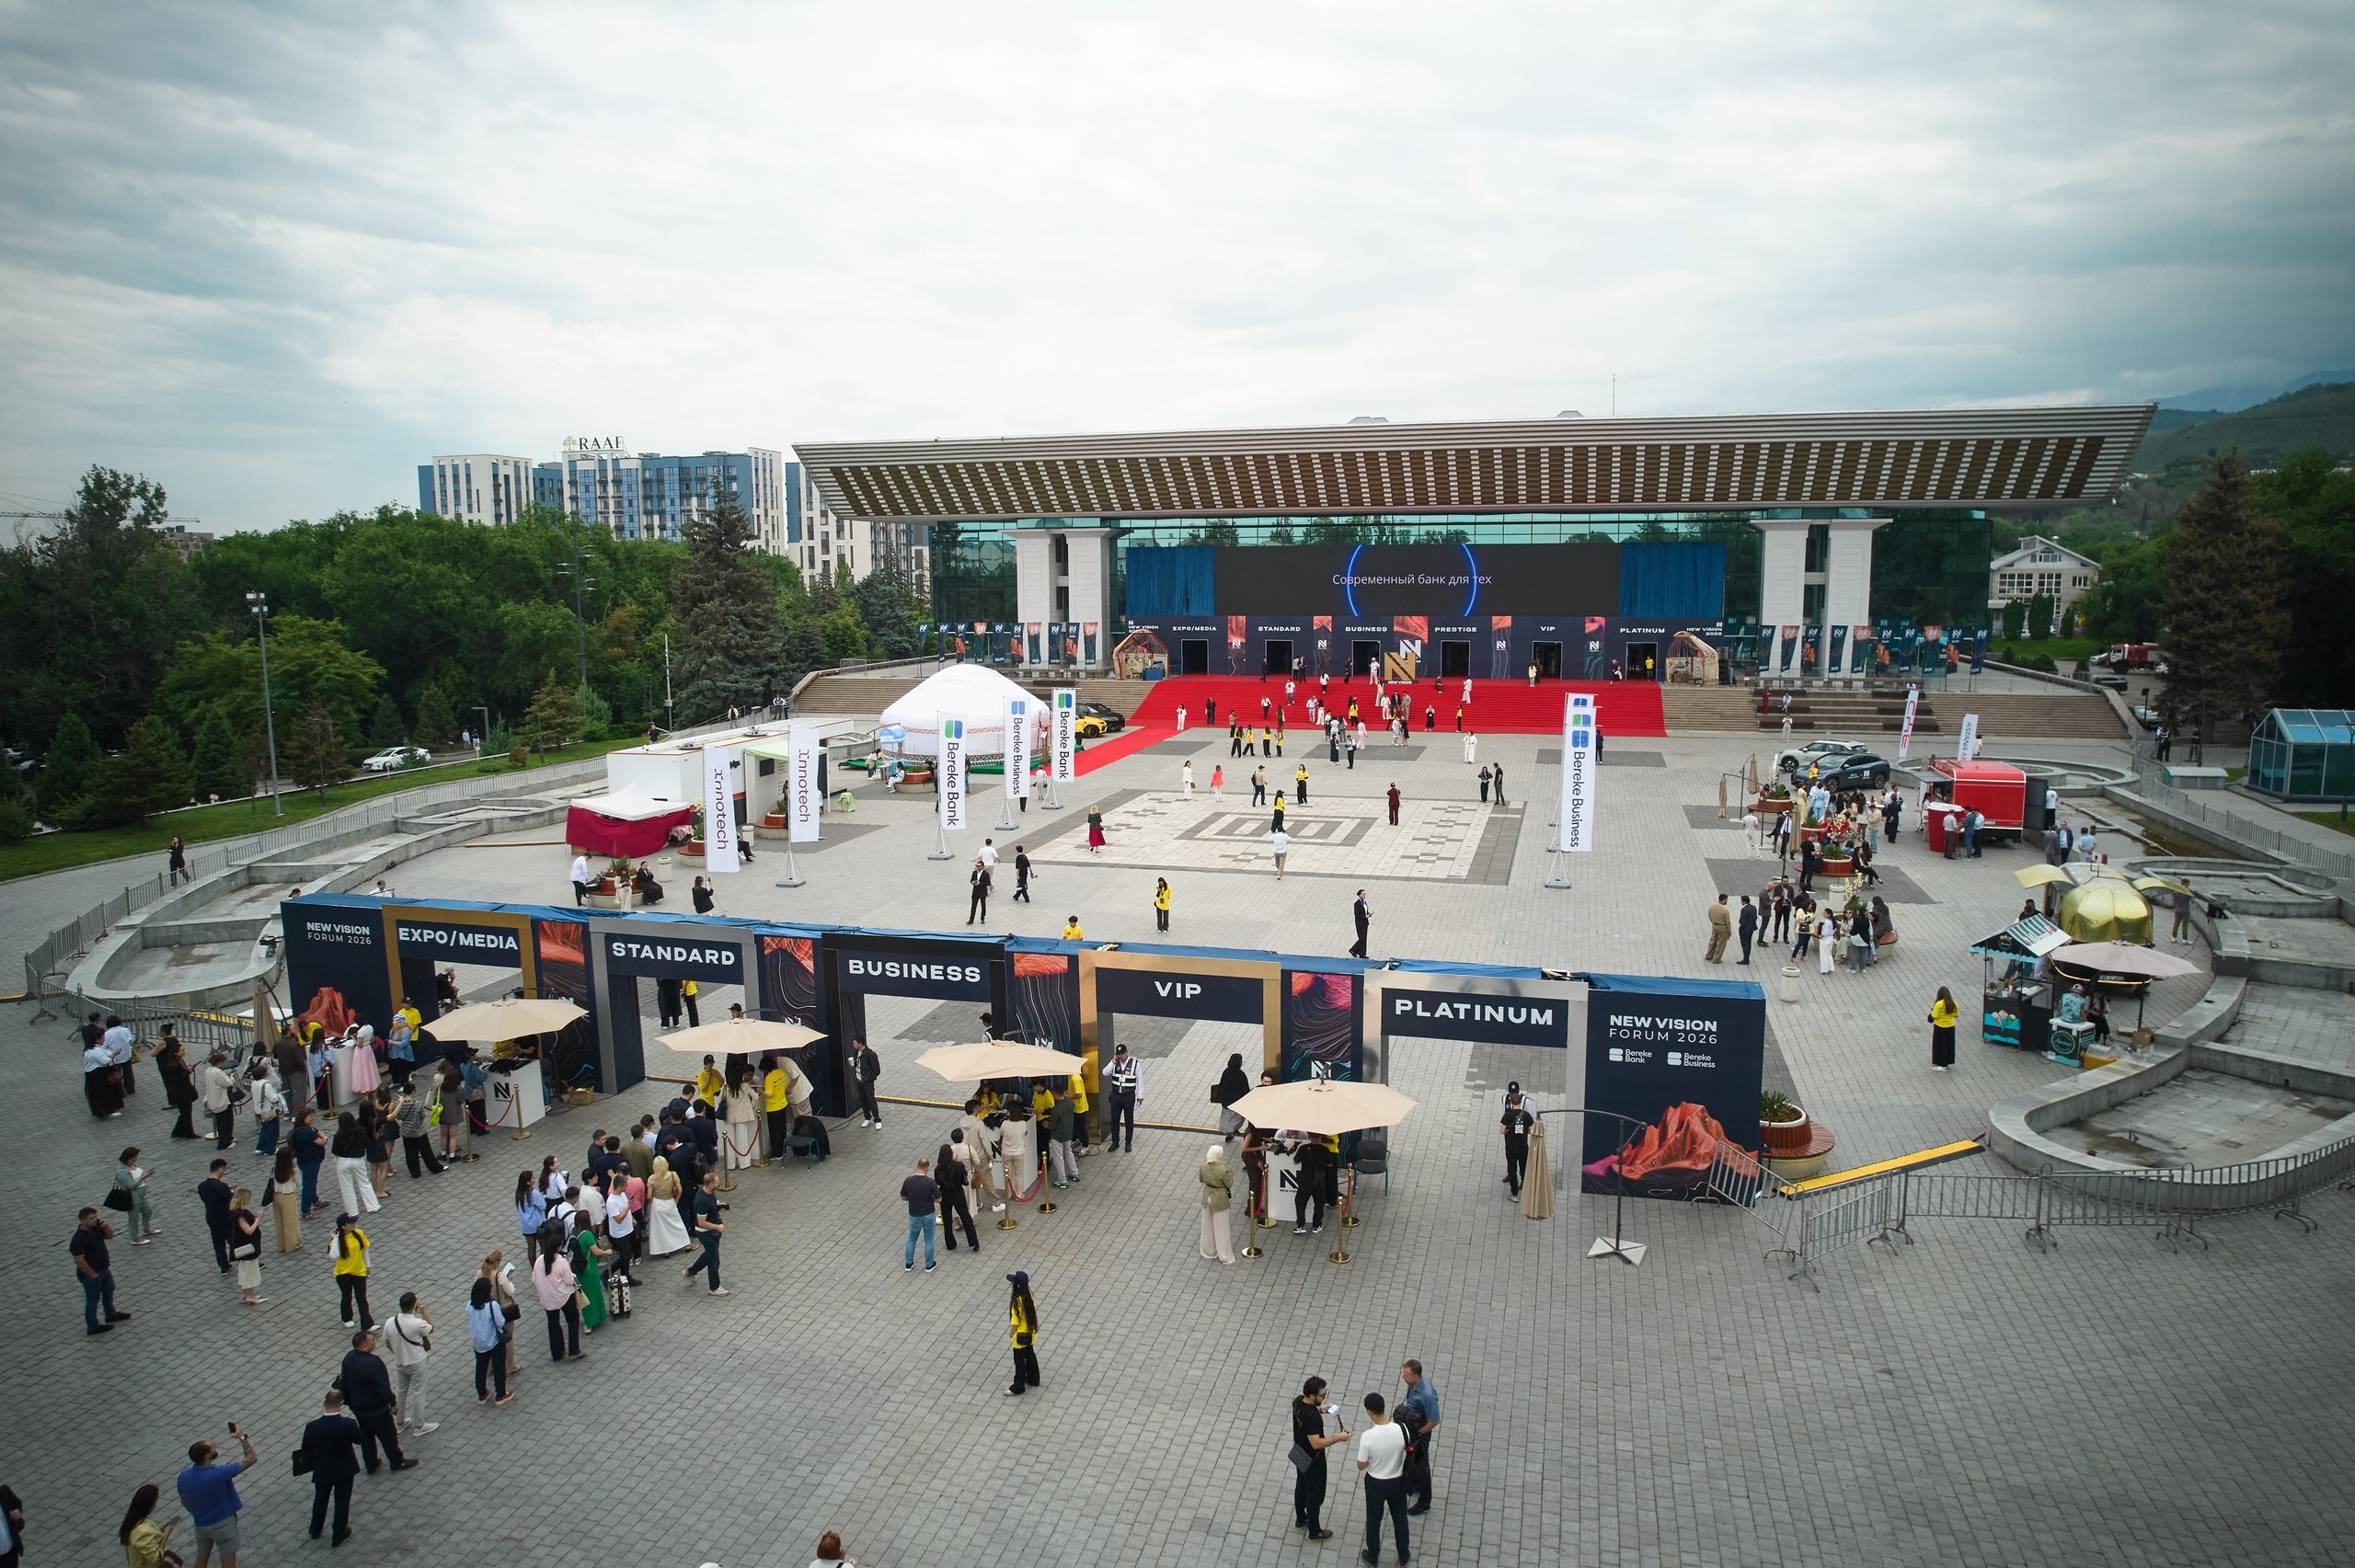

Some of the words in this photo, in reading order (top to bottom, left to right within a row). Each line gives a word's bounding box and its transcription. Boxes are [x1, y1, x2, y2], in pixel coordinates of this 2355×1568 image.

[1332, 574, 1415, 587] Современный
[1418, 574, 1446, 584] банк
[1448, 576, 1469, 587] для
[1473, 576, 1492, 584] тех
[1013, 717, 1023, 753] Bereke
[1059, 711, 1070, 749] Bereke
[1962, 721, 1971, 750] ASTANA
[947, 742, 959, 789] Bereke
[1013, 755, 1023, 795] Business
[1059, 751, 1070, 779] Bank
[1572, 751, 1585, 796] Bereke
[947, 792, 959, 826] Bank
[1570, 798, 1583, 848] Business
[306, 921, 332, 933] NEW
[333, 923, 371, 935] VISION
[307, 932, 344, 943] FORUM
[348, 935, 372, 945] 2026
[612, 941, 735, 966] STANDARD
[848, 959, 982, 983] BUSINESS
[1154, 980, 1202, 999] VIP
[1395, 999, 1553, 1026] PLATINUM
[1610, 1014, 1652, 1028] NEW
[1655, 1017, 1717, 1032] VISION
[1609, 1028, 1669, 1041] FORUM
[1677, 1032, 1717, 1045] 2026
[1625, 1049, 1652, 1058] Bereke
[1625, 1056, 1646, 1064] Bank
[1683, 1052, 1712, 1061] Bereke
[1683, 1059, 1716, 1068] Business
